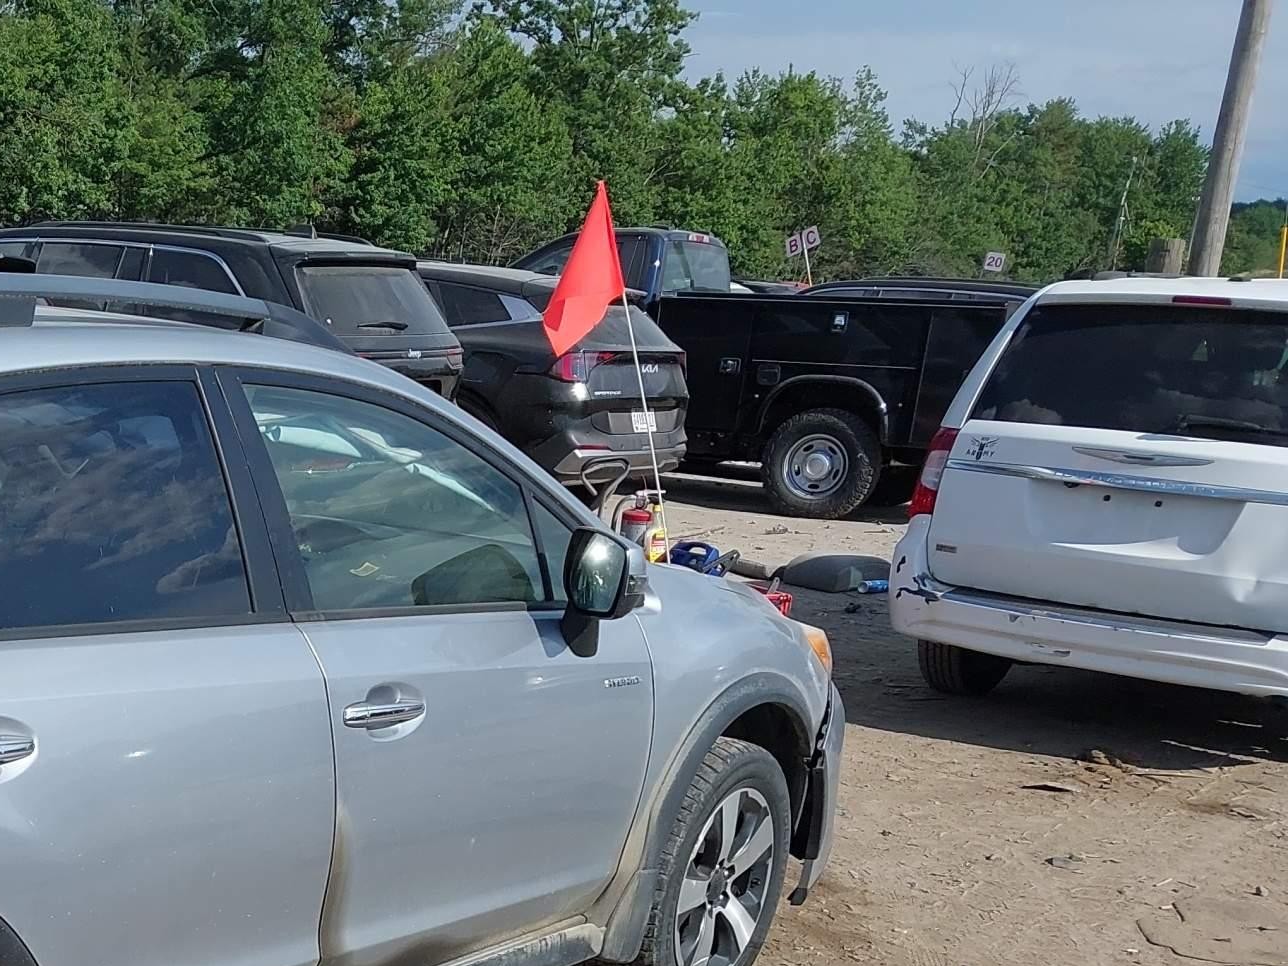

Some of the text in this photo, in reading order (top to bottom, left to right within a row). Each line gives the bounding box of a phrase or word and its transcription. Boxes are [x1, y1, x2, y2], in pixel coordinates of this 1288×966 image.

[806, 230, 817, 245] C
[789, 239, 799, 253] B
[987, 256, 1003, 268] 20
[407, 348, 422, 360] Jeep
[641, 364, 659, 373] KIA
